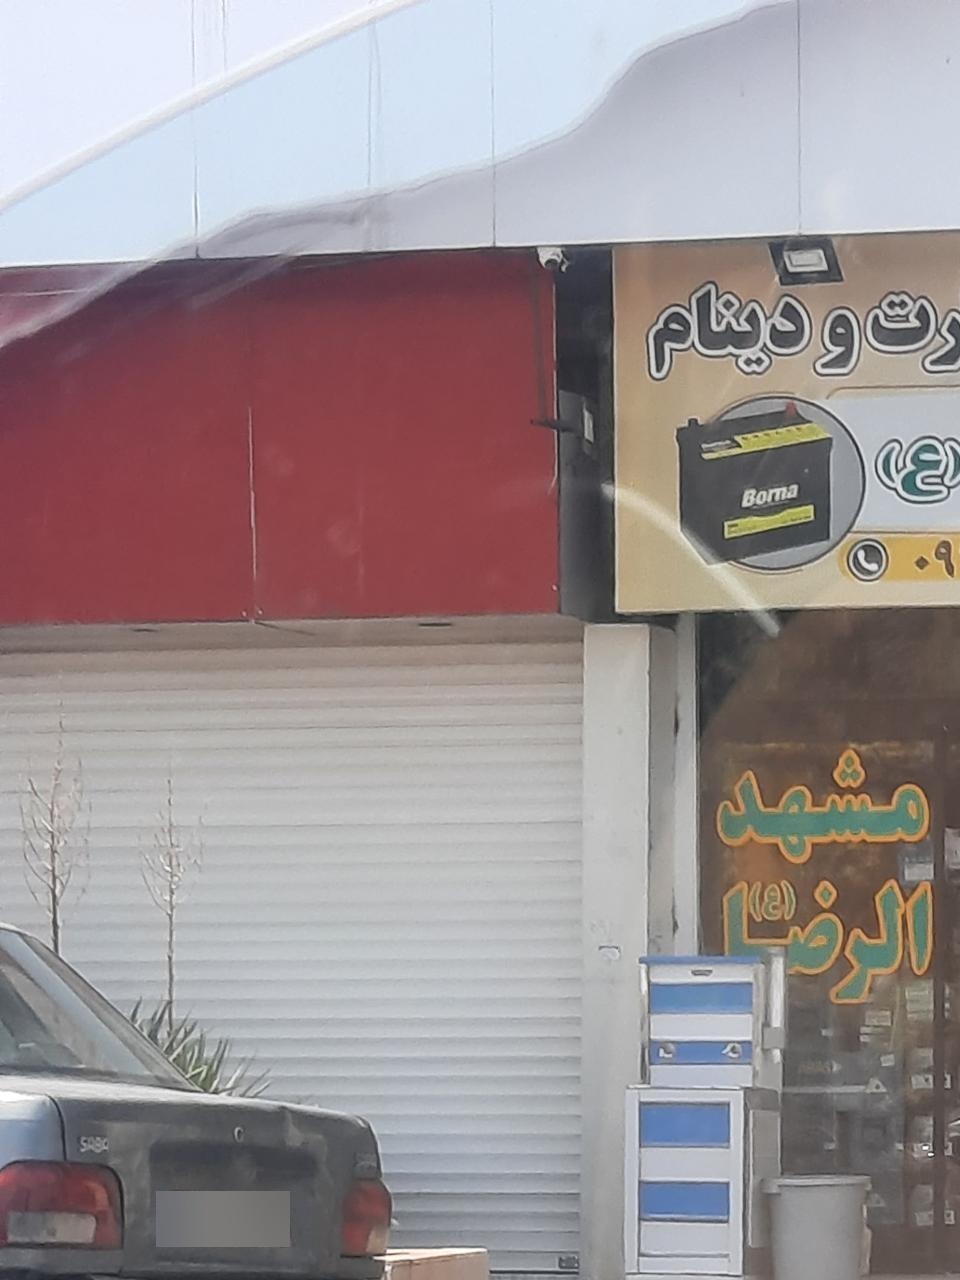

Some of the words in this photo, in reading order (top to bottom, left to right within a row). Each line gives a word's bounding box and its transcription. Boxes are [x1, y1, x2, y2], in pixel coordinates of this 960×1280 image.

[647, 281, 812, 381] دینام
[813, 306, 862, 377] و
[741, 483, 799, 509] Borna
[716, 749, 930, 864] مشهد
[723, 879, 933, 1004] الرضا
